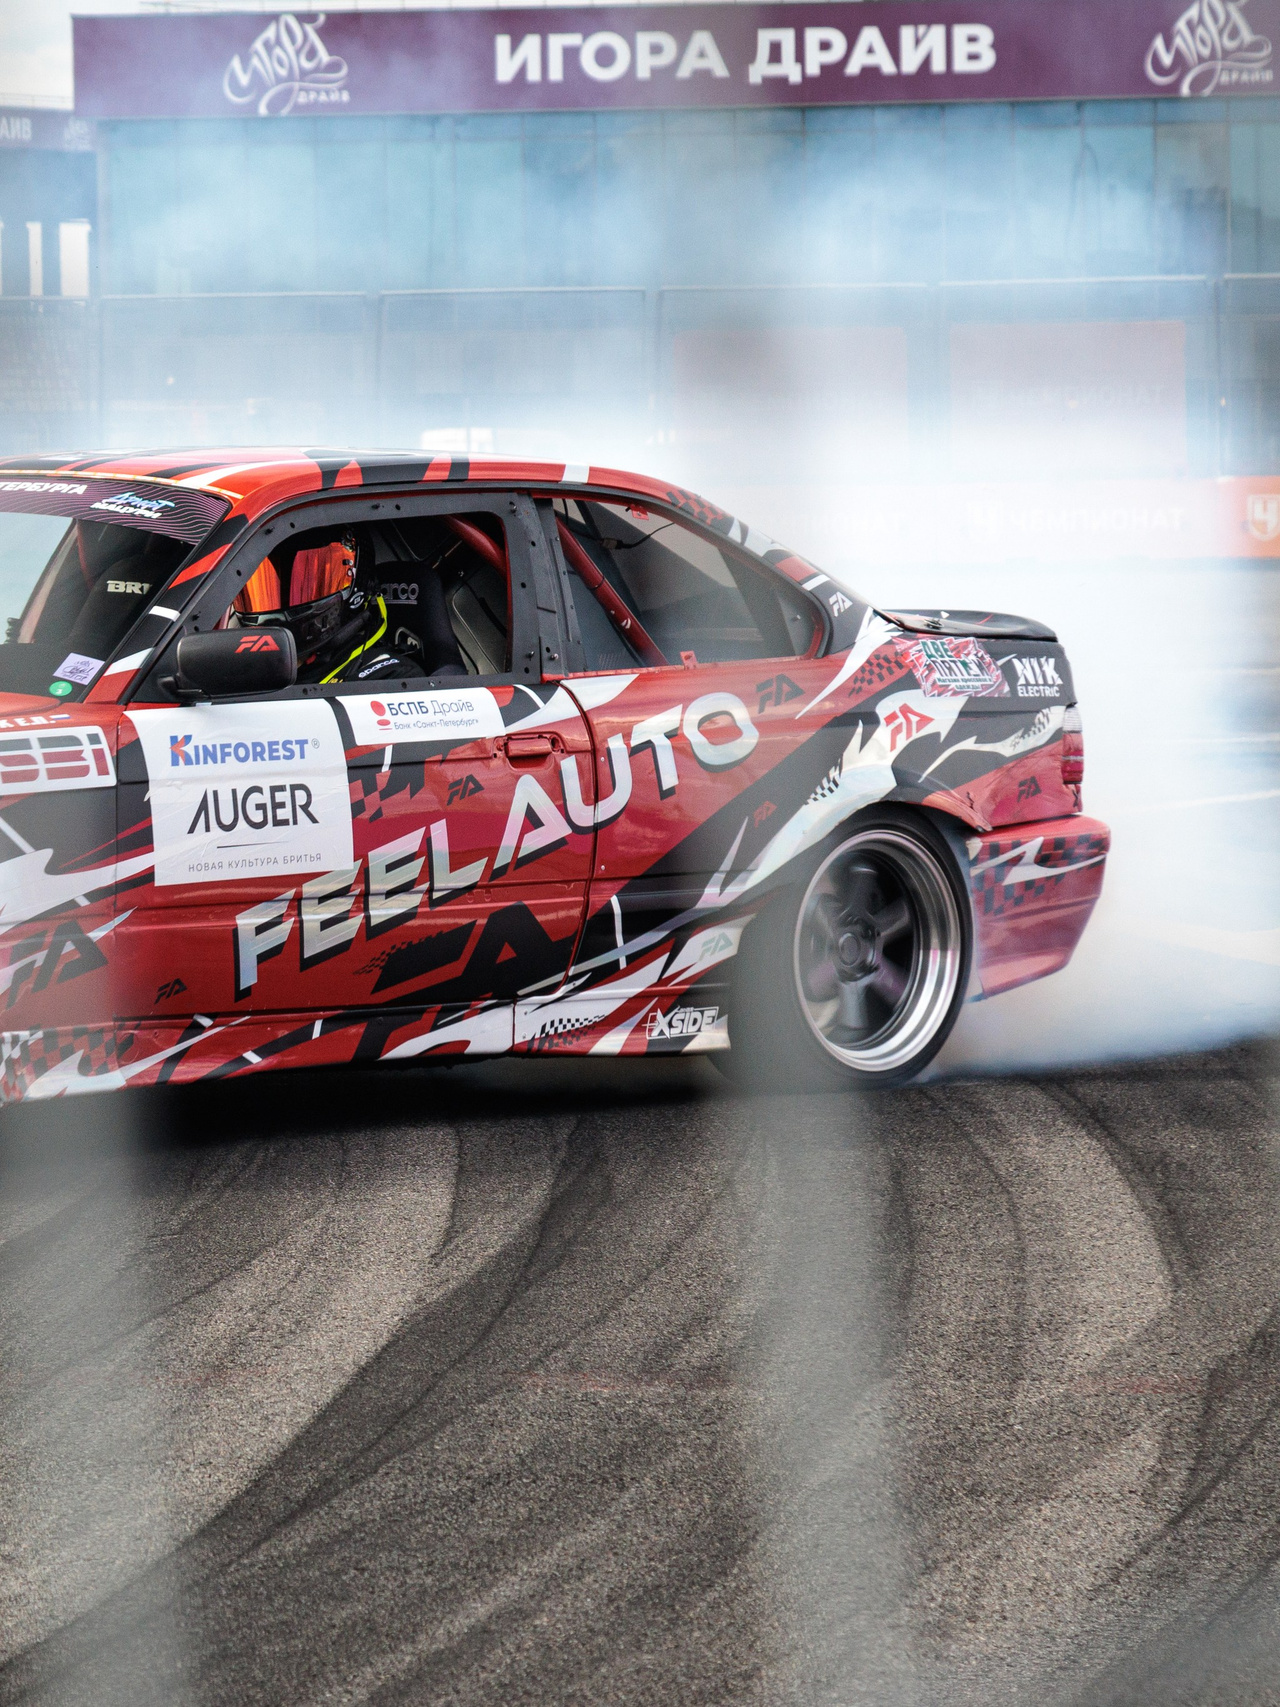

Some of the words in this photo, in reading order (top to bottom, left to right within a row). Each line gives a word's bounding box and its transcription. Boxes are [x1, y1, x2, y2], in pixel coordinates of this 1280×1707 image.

[495, 30, 730, 83] ИГОРА
[748, 22, 997, 84] ДРАЙВ
[381, 583, 419, 600] arco
[1018, 686, 1061, 698] ELECTRIC
[387, 701, 429, 716] БСПБ
[430, 700, 475, 716] Драйв
[394, 722, 411, 730] Банк
[187, 783, 320, 835] AUGER
[188, 861, 223, 872] НОВАЯ
[228, 856, 278, 869] КУЛЬТУРА
[283, 853, 322, 865] БРИТЬЯ
